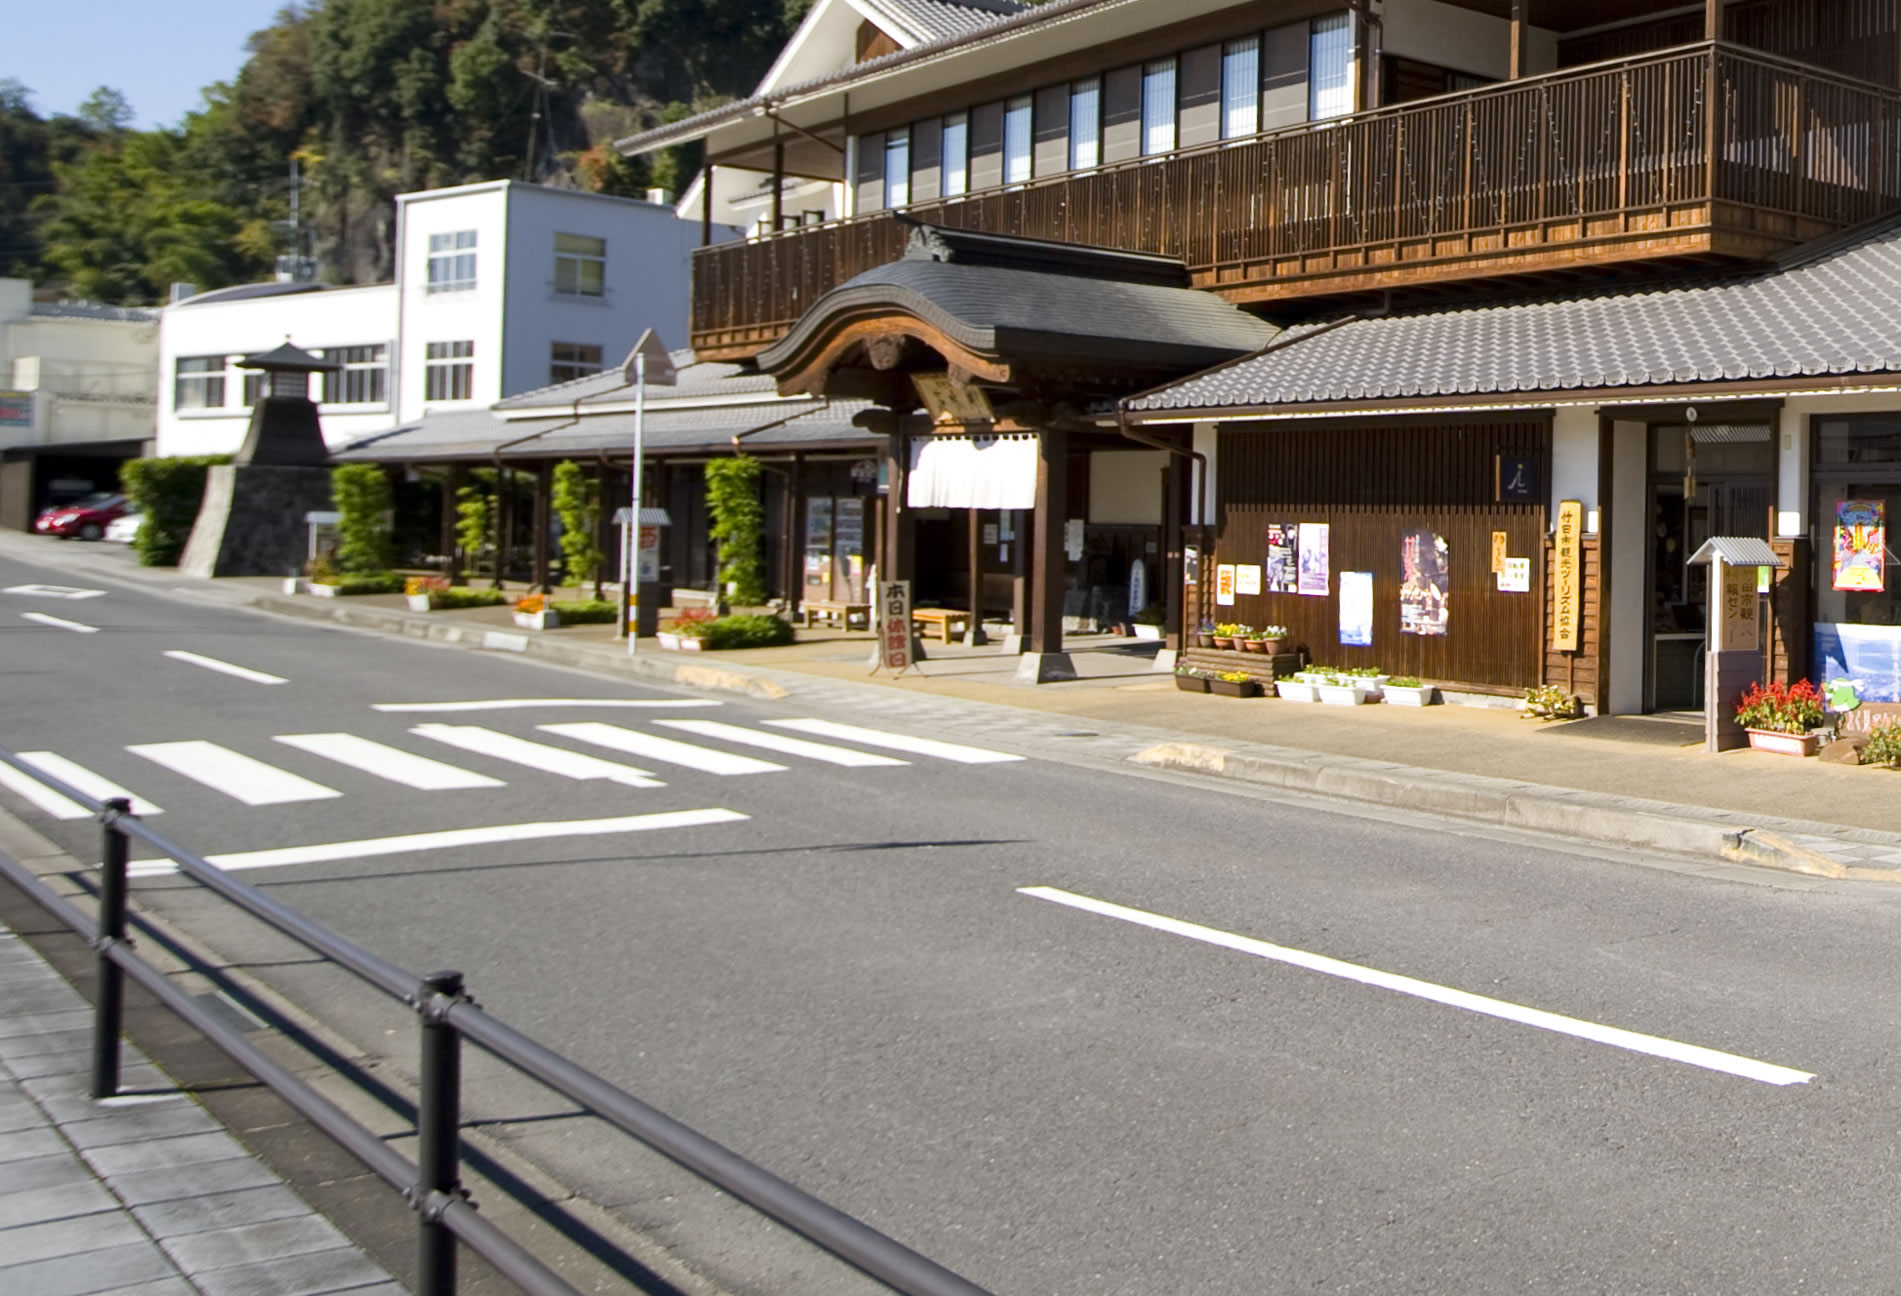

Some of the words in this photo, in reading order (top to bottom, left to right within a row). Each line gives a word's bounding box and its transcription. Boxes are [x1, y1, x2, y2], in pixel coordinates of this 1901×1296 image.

[886, 583, 907, 668] 本日休館日
[1560, 510, 1572, 640] 竹田市観光ツーリズム協会
